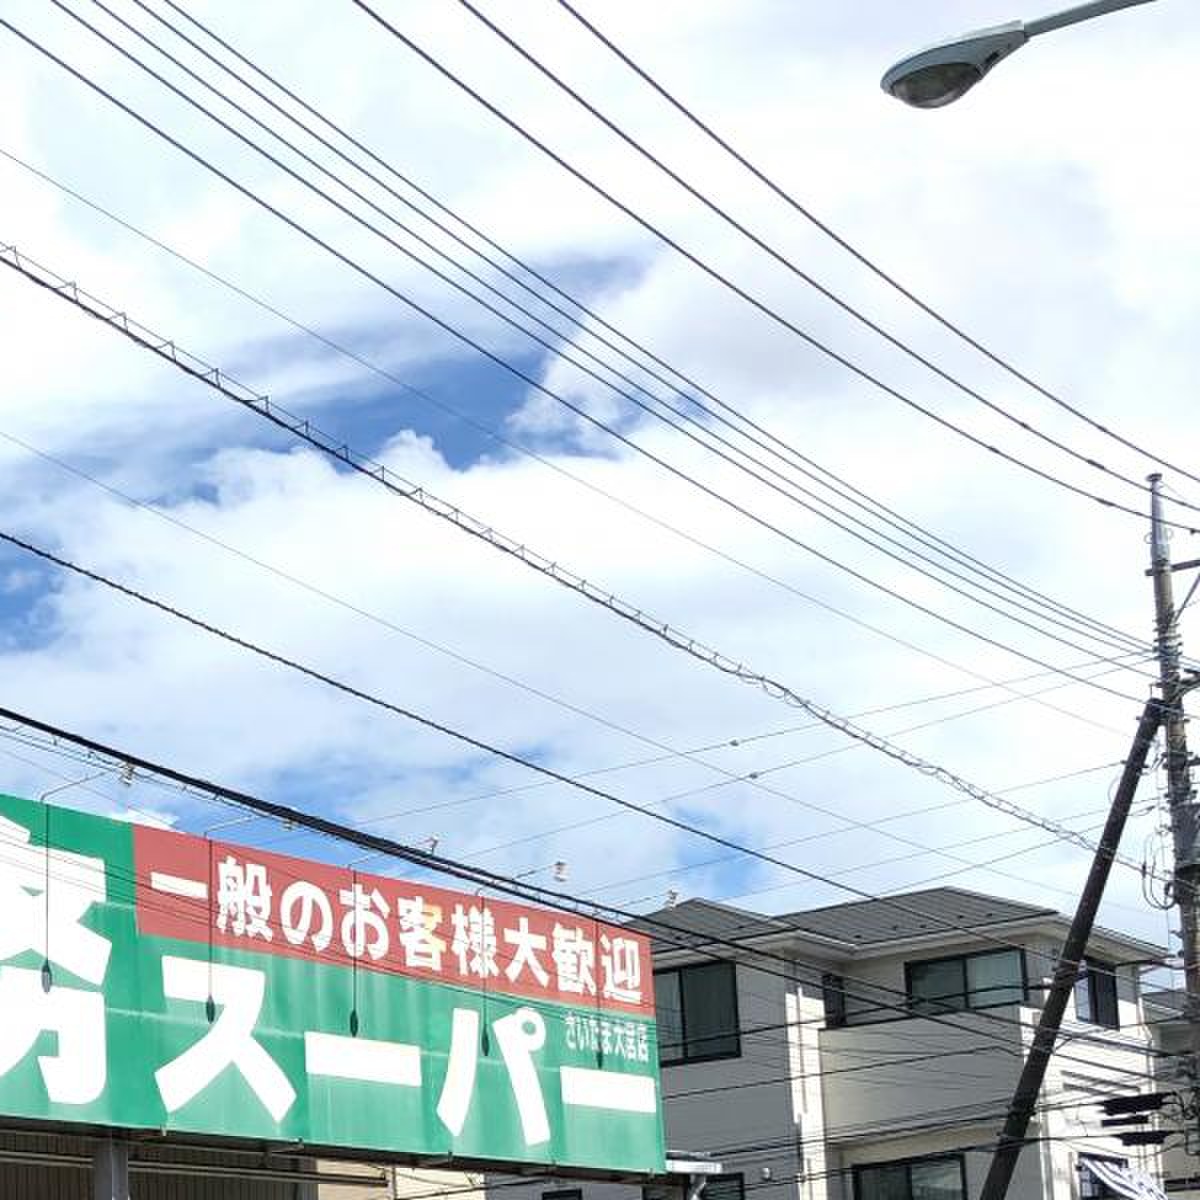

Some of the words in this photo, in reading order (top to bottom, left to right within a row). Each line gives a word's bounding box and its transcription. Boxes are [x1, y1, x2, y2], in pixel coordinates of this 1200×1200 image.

[150, 854, 642, 1003] 一般のお客様大歓迎
